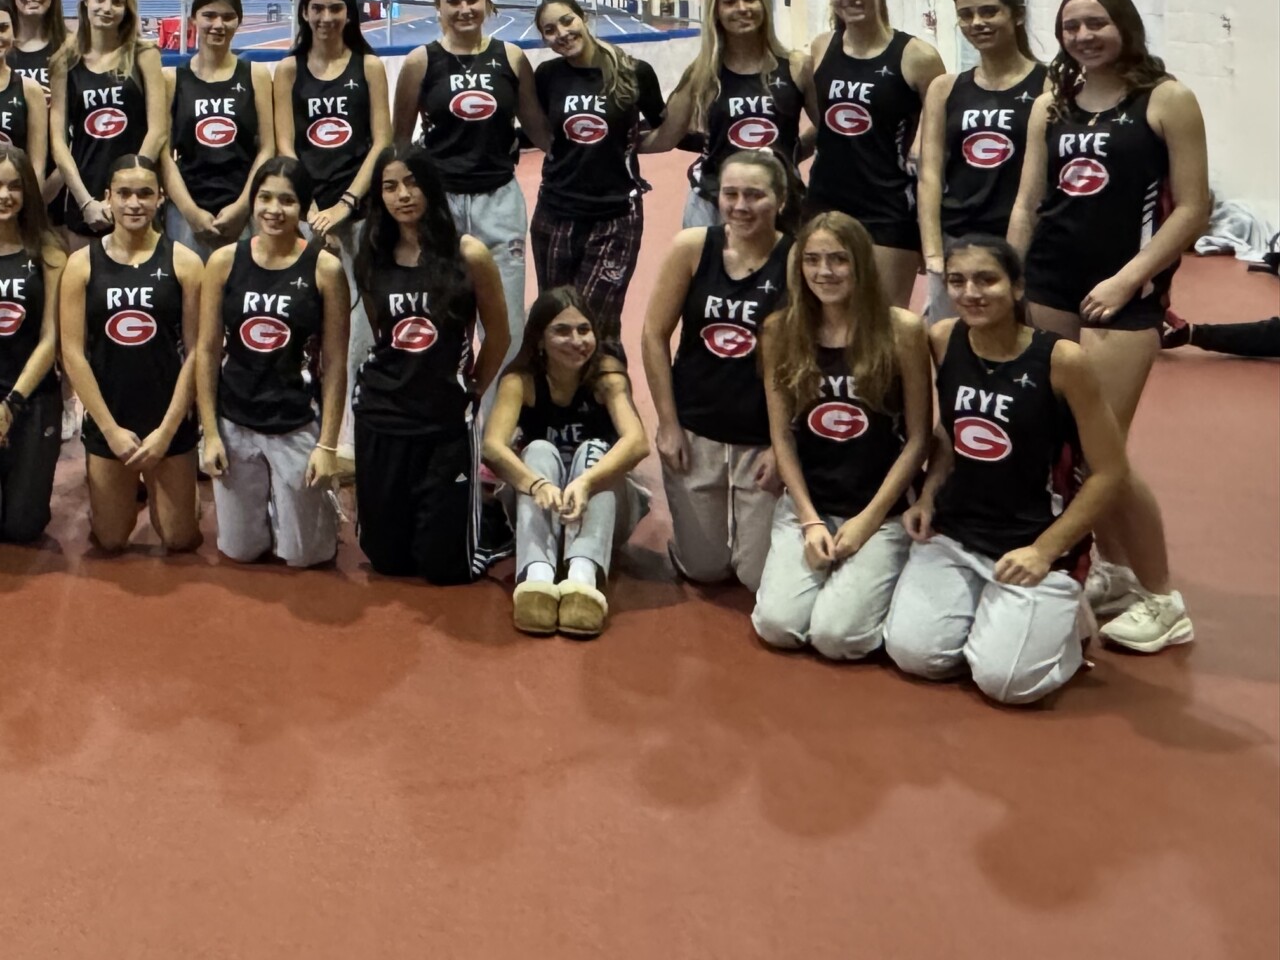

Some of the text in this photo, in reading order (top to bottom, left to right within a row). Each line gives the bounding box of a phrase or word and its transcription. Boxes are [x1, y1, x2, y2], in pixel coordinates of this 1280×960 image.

[450, 73, 493, 91] RYE
[829, 79, 874, 104] RYE
[83, 86, 124, 109] RYE
[195, 98, 235, 117] RYE
[308, 96, 348, 117] RYE
[564, 95, 606, 114] RYE
[729, 96, 774, 117] RYE
[962, 109, 1014, 130] RYE
[1059, 132, 1110, 157] RYE
[107, 287, 153, 310] RYE
[243, 292, 291, 317] RYE
[704, 295, 758, 324] RYE
[954, 385, 1013, 422] RYE
